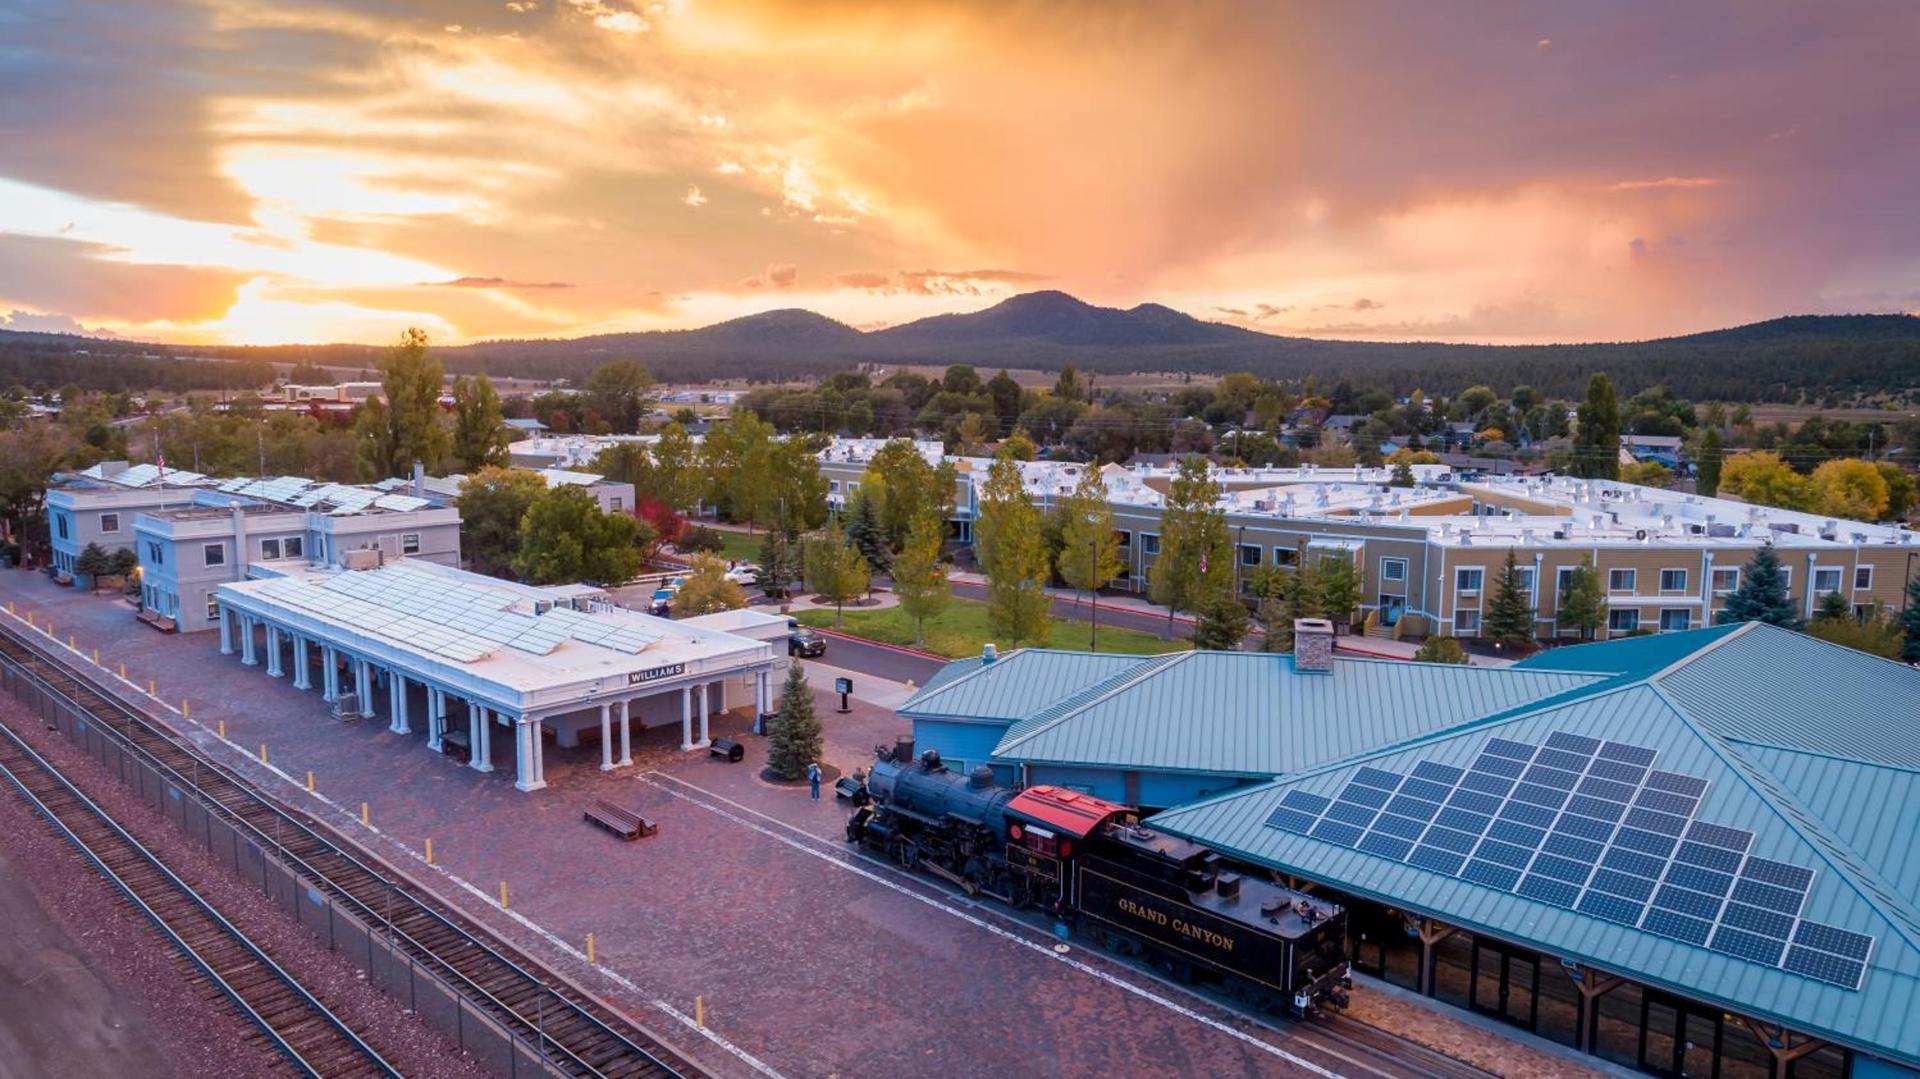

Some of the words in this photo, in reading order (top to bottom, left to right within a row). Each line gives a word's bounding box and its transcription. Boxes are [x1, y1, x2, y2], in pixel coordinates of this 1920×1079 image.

[631, 665, 682, 682] WILLIAMS
[1118, 898, 1168, 926] GRAND
[1172, 919, 1235, 951] CANYON
